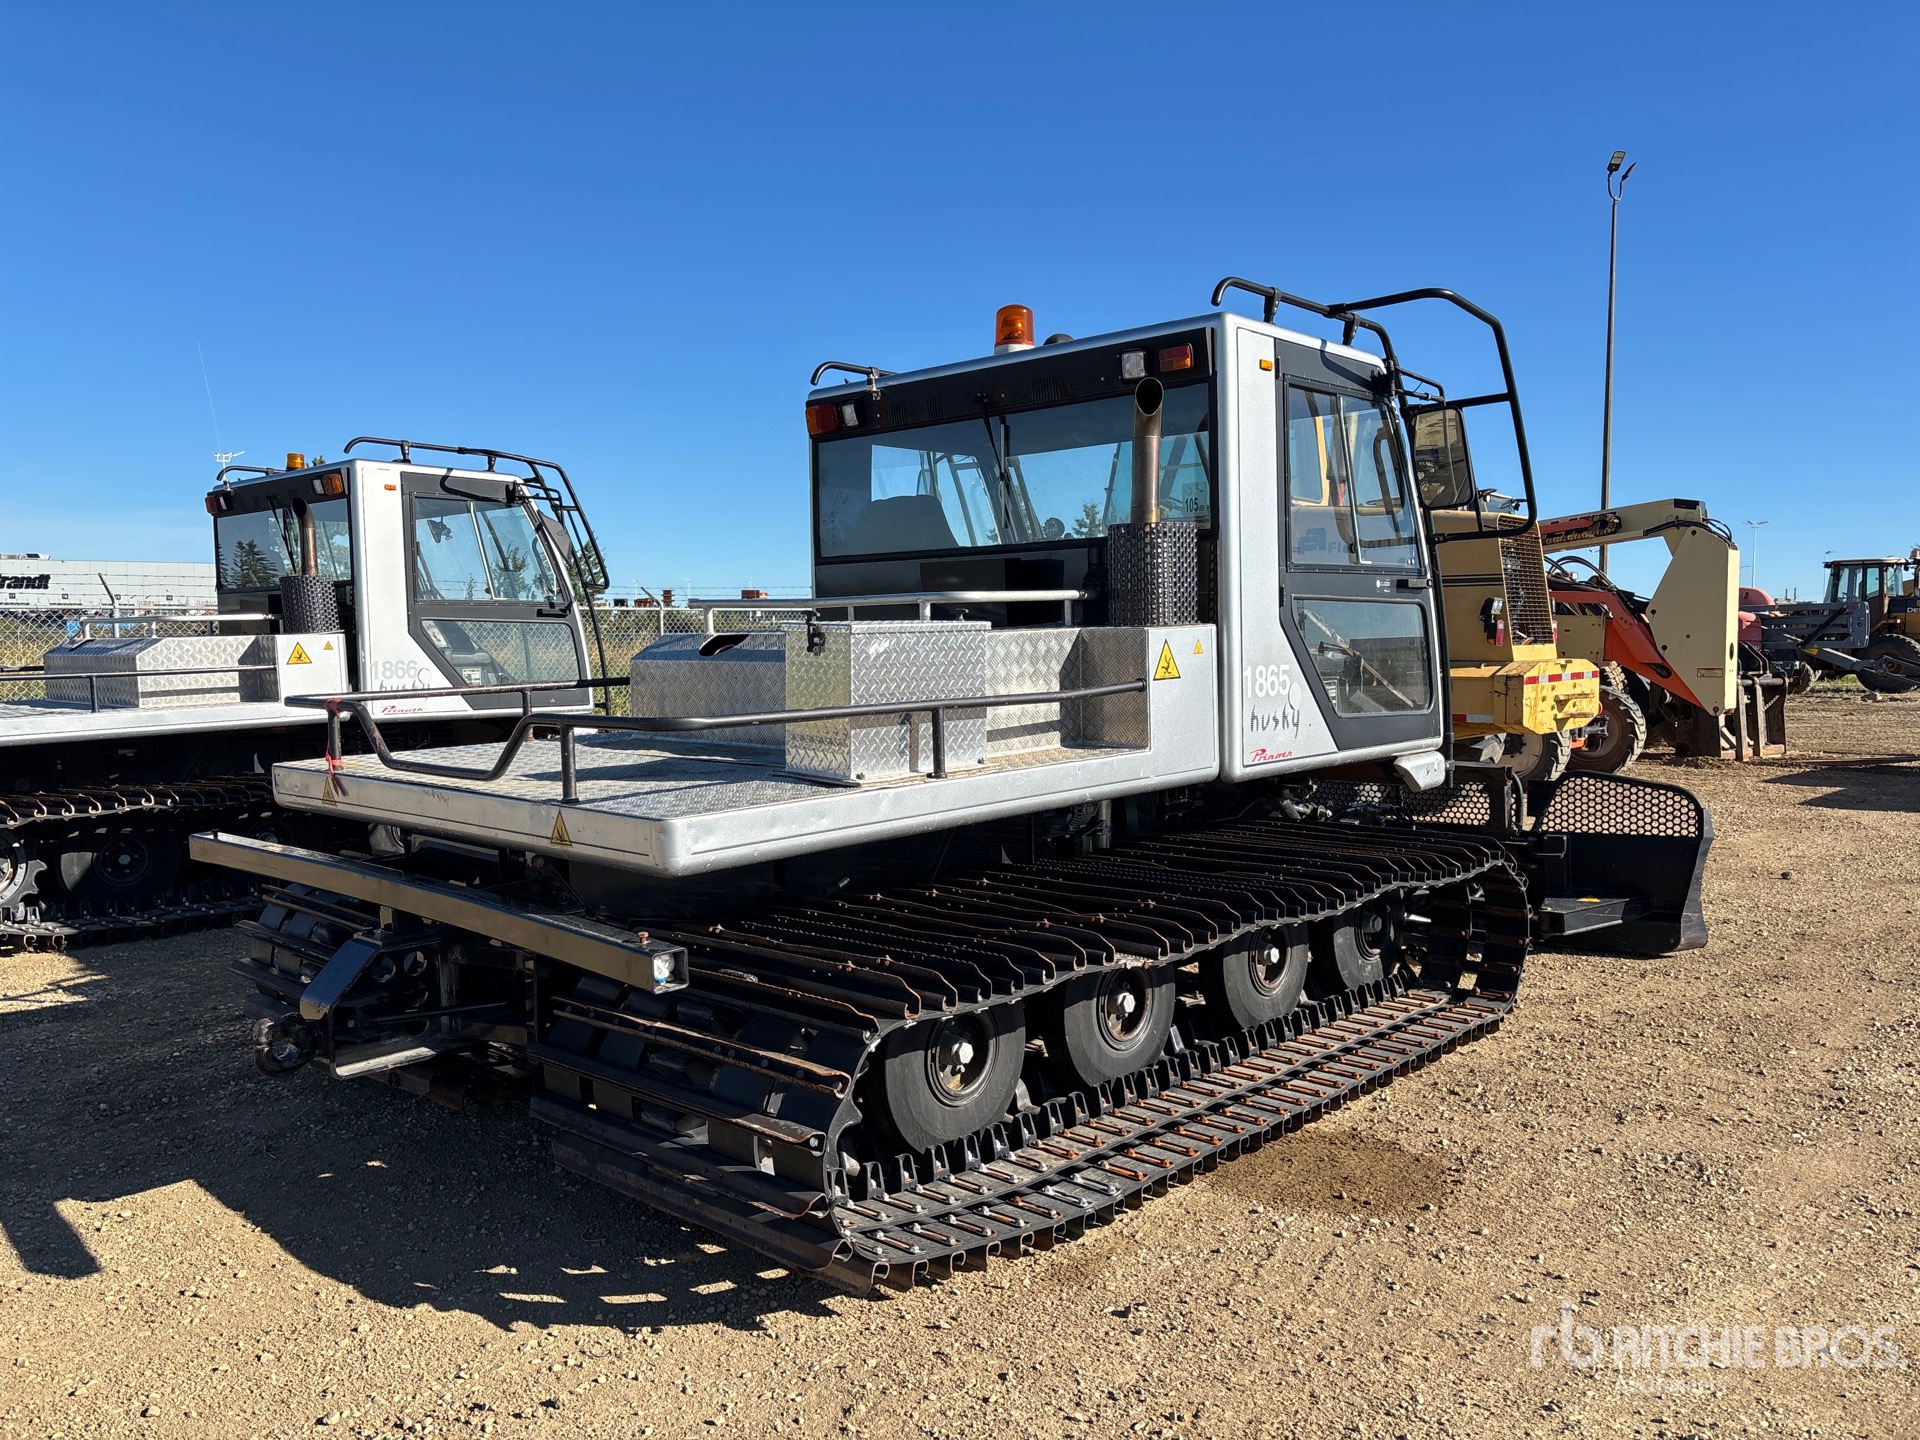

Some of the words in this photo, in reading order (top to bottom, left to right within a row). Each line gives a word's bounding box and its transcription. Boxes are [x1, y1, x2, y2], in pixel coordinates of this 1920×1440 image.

[1185, 498, 1198, 512] 105
[0, 573, 51, 589] randt
[371, 660, 418, 679] 1866
[1244, 664, 1290, 698] 1865
[1250, 704, 1301, 738] husky
[1250, 748, 1293, 762] Prinoth
